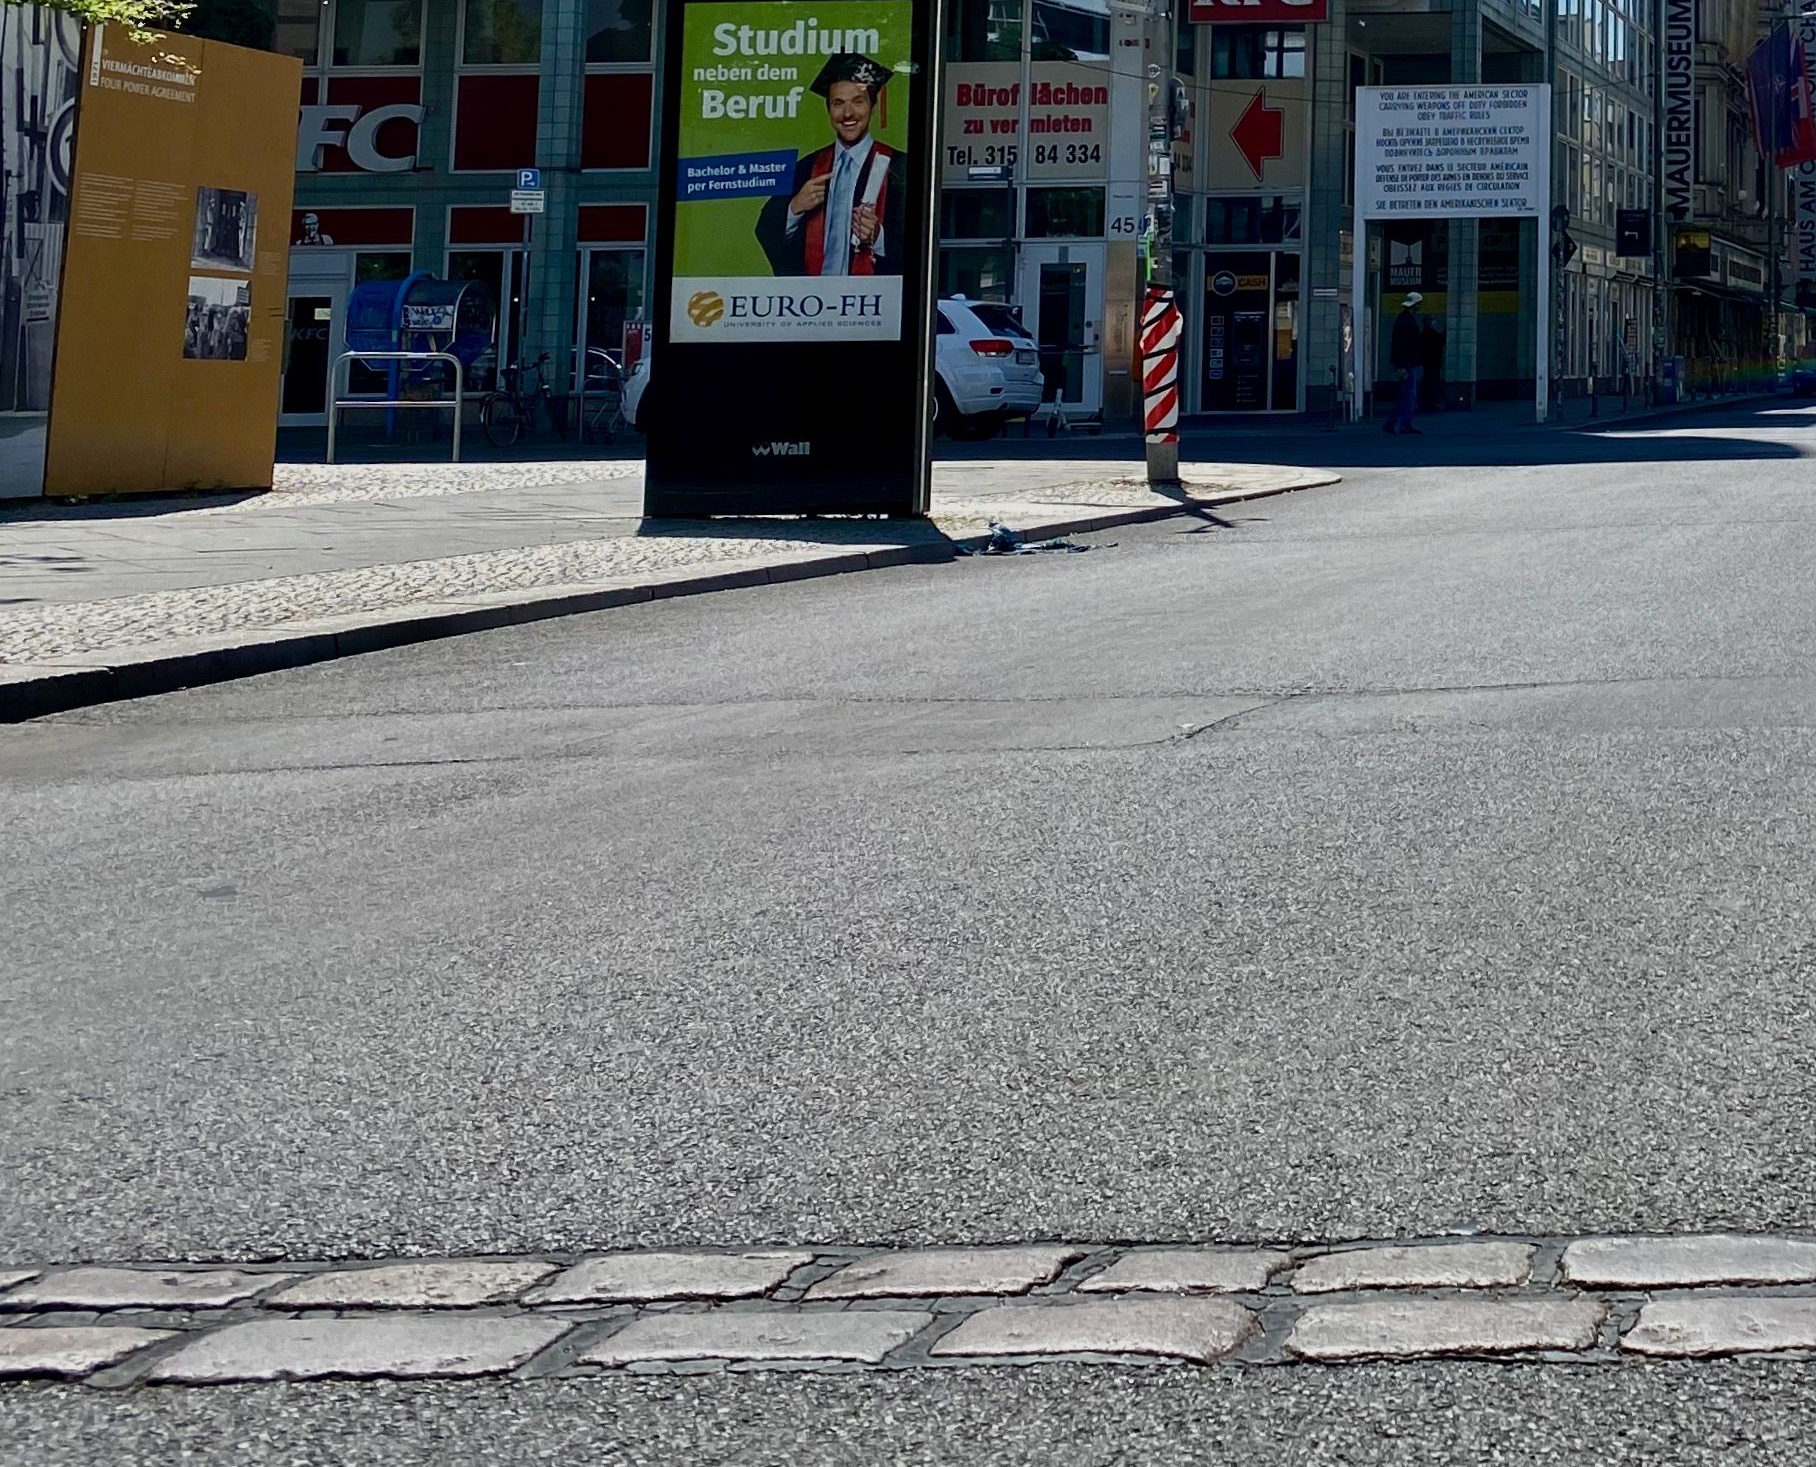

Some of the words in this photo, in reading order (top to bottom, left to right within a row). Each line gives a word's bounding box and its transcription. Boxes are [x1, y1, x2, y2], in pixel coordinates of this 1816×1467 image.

[712, 17, 879, 56] Studium
[693, 64, 752, 81] neben
[757, 63, 798, 80] dem
[100, 77, 122, 90] FOUR
[123, 80, 150, 96] POWER
[150, 86, 195, 103] AGREEMENT
[957, 82, 1108, 107] Büroflächen
[1380, 92, 1394, 101] YOU
[1397, 92, 1410, 100] ARE
[1414, 91, 1445, 100] ENTERING
[1449, 91, 1460, 99] THE
[1464, 91, 1498, 99] AMERICAN
[1502, 90, 1528, 99] SECTOR
[702, 87, 805, 119] Beruf
[1379, 103, 1414, 111] CARRYING
[1417, 102, 1450, 110] WEAPONS
[1453, 101, 1465, 109] OFF
[1469, 101, 1486, 109] DUTY
[1489, 100, 1527, 109] FORBIDDEN
[1417, 112, 1436, 120] OBEY
[1439, 111, 1466, 119] TRAFFIC
[1470, 111, 1490, 119] RULES
[963, 119, 984, 134] zu
[990, 115, 1092, 134] vermieten
[296, 103, 425, 172] FC
[947, 146, 978, 165] Tel.
[985, 145, 1018, 165] 315
[1035, 145, 1058, 164] 84
[1066, 144, 1101, 164] 334
[687, 165, 736, 177] Bachelor
[738, 165, 747, 175] &
[749, 163, 787, 173] Master
[1376, 164, 1395, 173] VOUS
[1398, 164, 1422, 172] ENTREZ
[1426, 164, 1444, 172] DANS
[1457, 163, 1487, 171] SECTEUR
[1409, 173, 1429, 181] PORTER
[1431, 173, 1442, 181] DES
[1443, 173, 1461, 181] ARMES
[1462, 173, 1471, 181] EN
[1506, 172, 1529, 181] SERVICE
[687, 183, 707, 193] per
[708, 177, 776, 190] Fernstudium
[1465, 183, 1473, 191] DE
[1476, 183, 1520, 191] CIRCULATION
[1376, 200, 1386, 209] SIE
[1389, 200, 1421, 209] BETRETEN
[1424, 200, 1438, 209] DEN
[1440, 199, 1498, 208] AMERIKANISCHEN
[1501, 198, 1527, 207] SEKTOR
[1800, 180, 1816, 214] AM
[1111, 217, 1134, 233] 45
[1800, 219, 1816, 272] HAUS
[1238, 277, 1266, 287] CASH
[730, 294, 882, 317] EURO-FH
[771, 441, 810, 455] Wall
